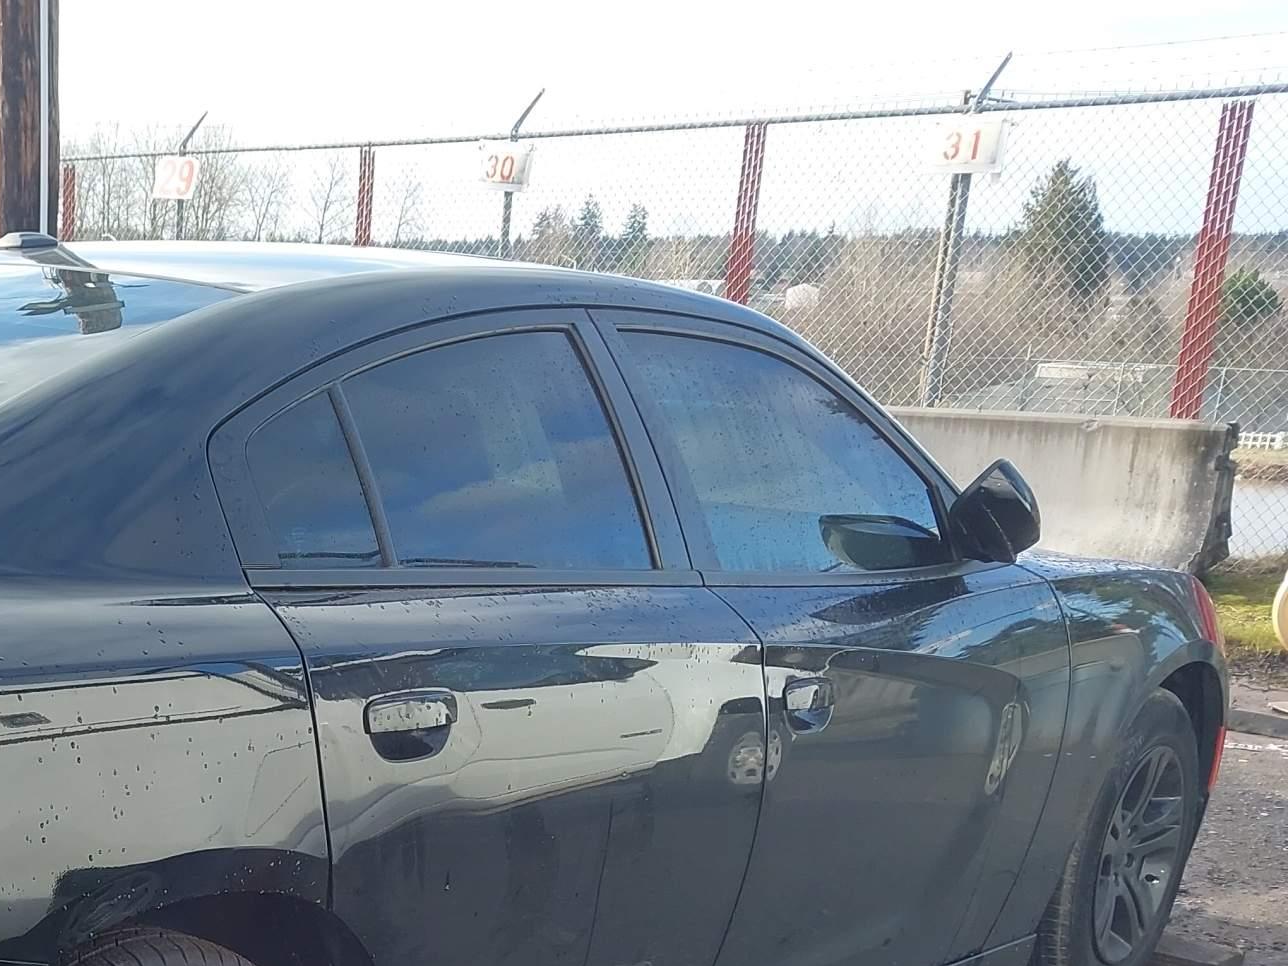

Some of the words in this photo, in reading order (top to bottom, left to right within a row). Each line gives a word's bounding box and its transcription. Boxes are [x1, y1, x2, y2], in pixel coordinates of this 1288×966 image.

[943, 129, 982, 161] 31
[160, 159, 194, 196] 29
[486, 154, 515, 181] 30
